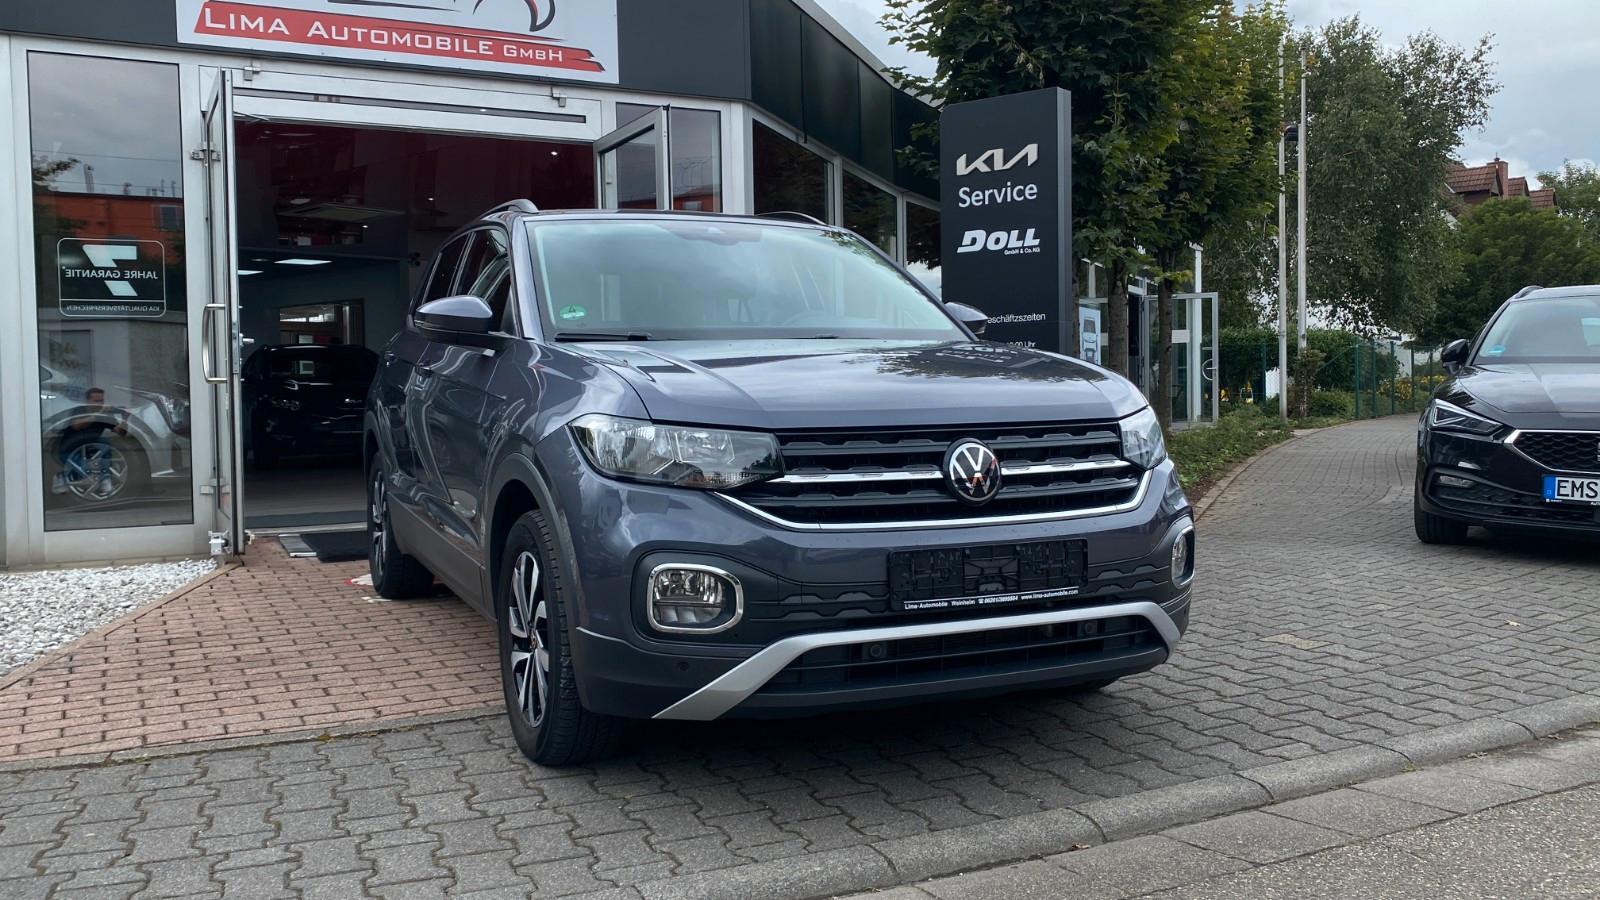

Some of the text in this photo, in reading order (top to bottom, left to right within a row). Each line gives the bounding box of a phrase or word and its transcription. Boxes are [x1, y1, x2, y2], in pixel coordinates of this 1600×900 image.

[956, 143, 1039, 176] KIA
[958, 181, 1038, 208] Service
[957, 228, 1040, 253] DOLL
[1557, 480, 1598, 499] EMS
